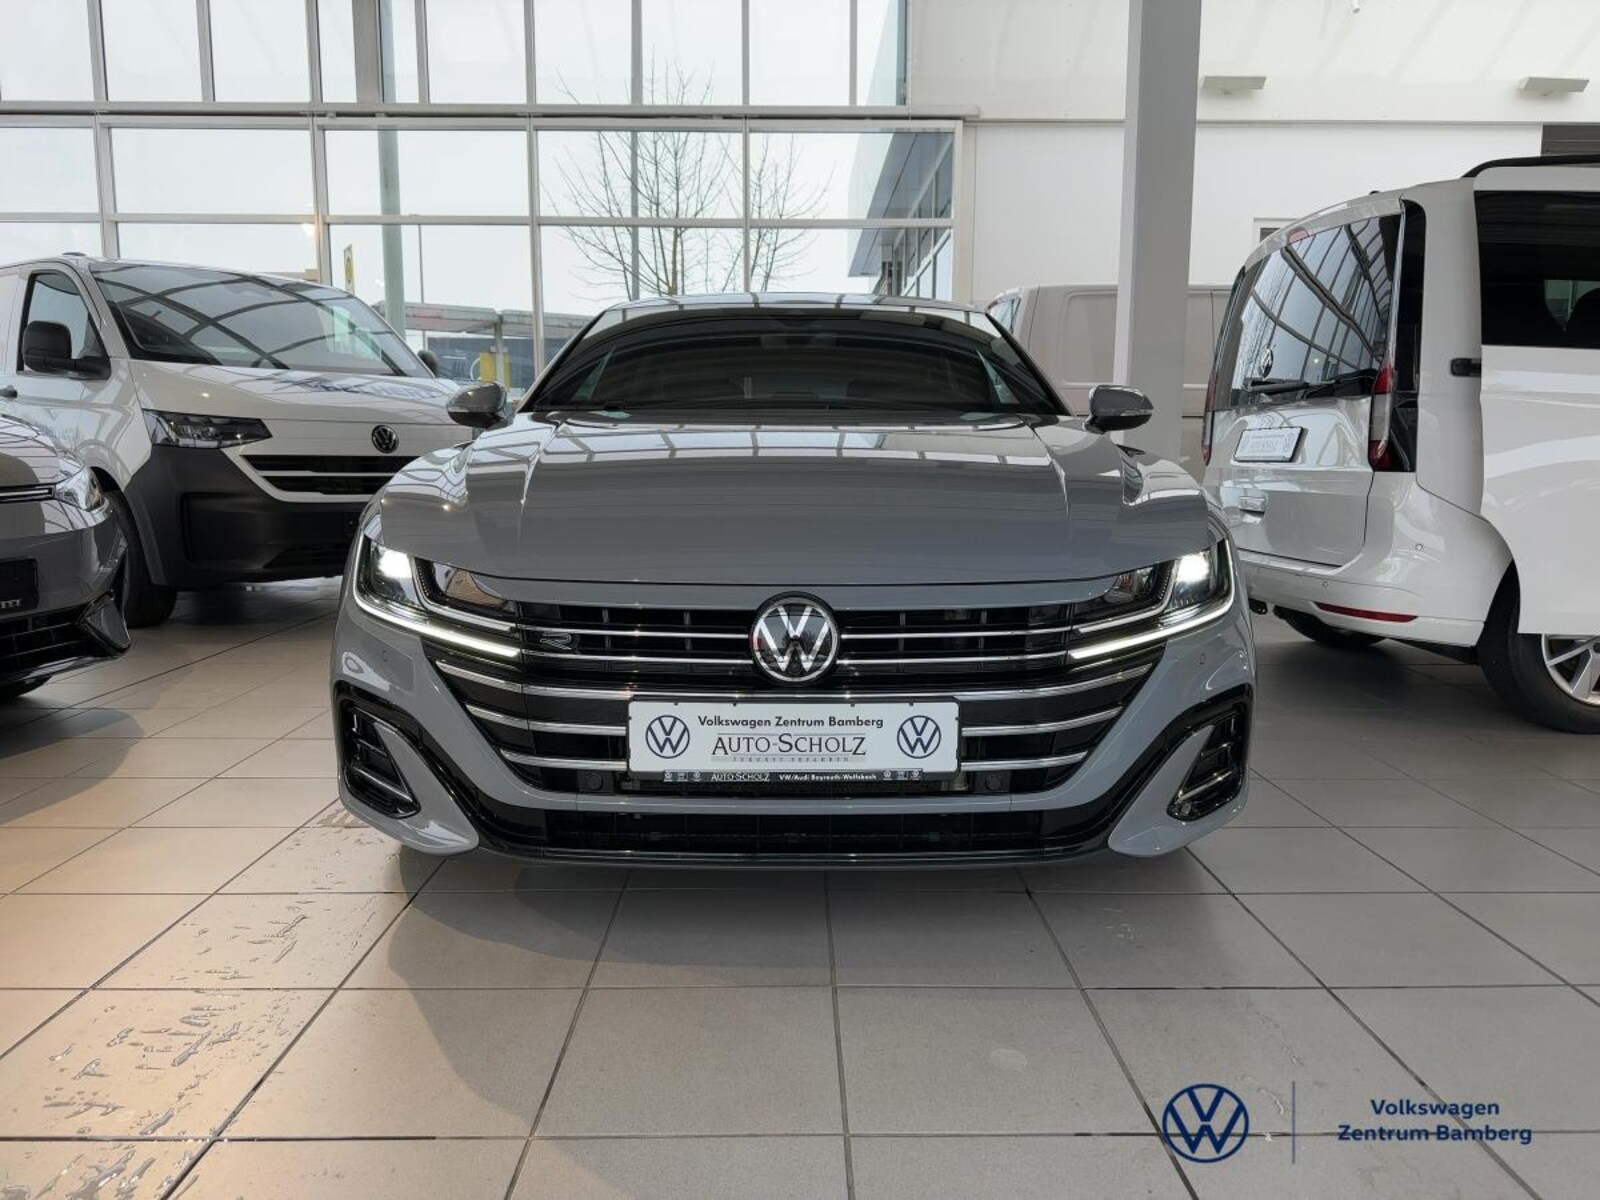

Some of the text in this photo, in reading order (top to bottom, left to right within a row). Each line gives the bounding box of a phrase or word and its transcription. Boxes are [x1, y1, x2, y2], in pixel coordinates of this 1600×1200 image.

[753, 597, 838, 682] VW
[645, 715, 690, 758] VW
[698, 716, 884, 728] Volkswagen Zentrum Bamberg
[897, 715, 942, 758] VW
